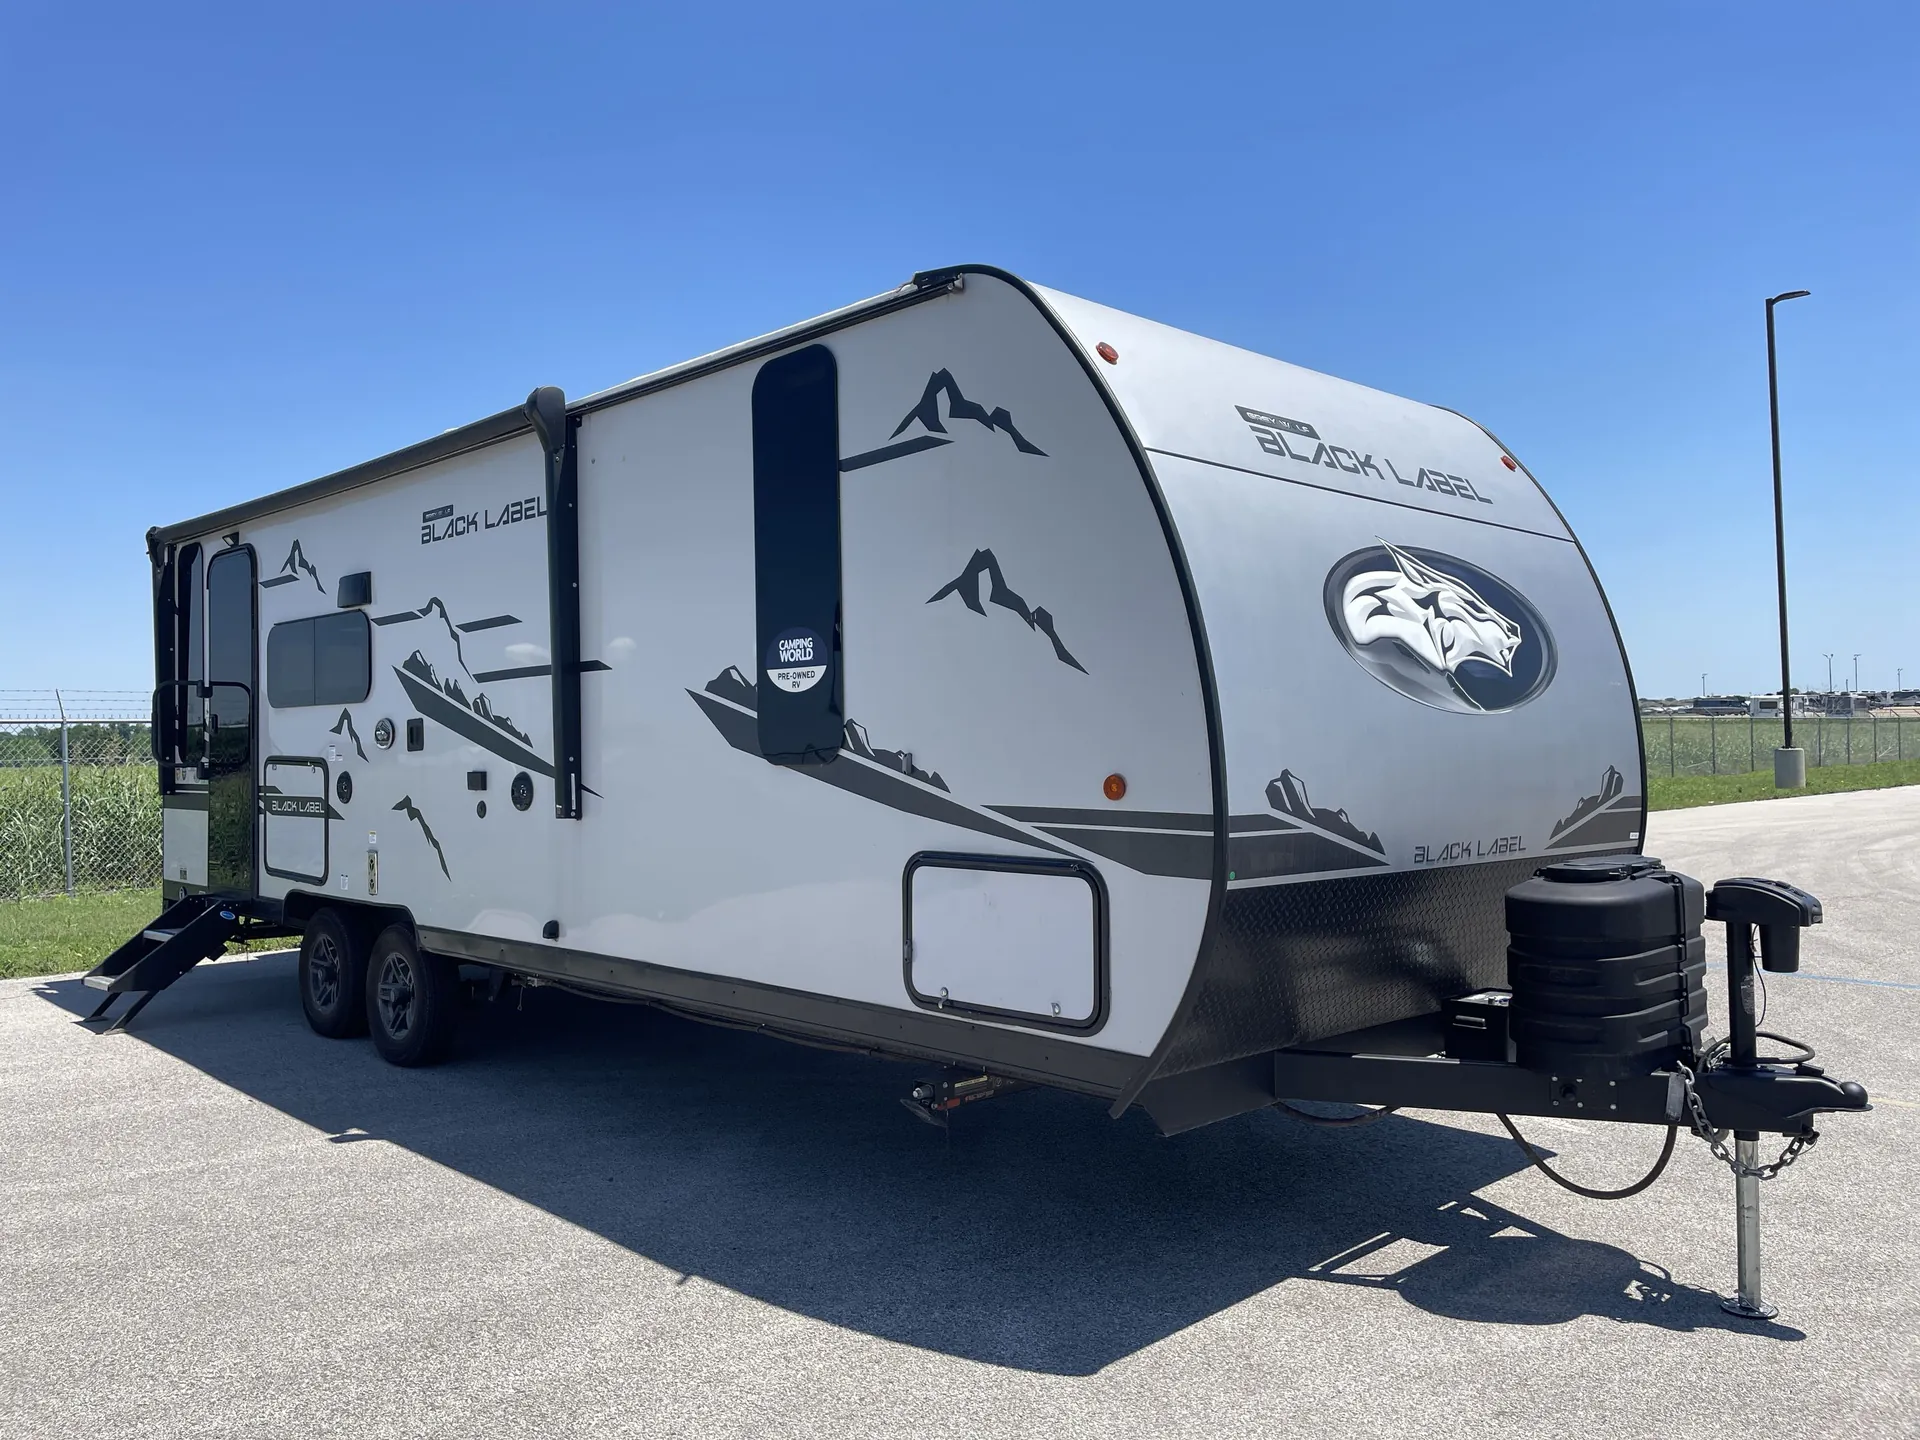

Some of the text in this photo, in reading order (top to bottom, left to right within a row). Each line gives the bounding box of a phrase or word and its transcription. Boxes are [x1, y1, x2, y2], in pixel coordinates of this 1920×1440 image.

[1249, 424, 1494, 505] BLACK LABEL
[421, 496, 547, 545] BLACK LABEL
[778, 637, 814, 651] CAMPING
[779, 647, 814, 663] WORLD
[777, 670, 816, 681] PRE-OWNED
[791, 680, 801, 689] RV
[271, 800, 325, 814] BLACK LABEL
[1413, 835, 1527, 864] BLACK LABEL
